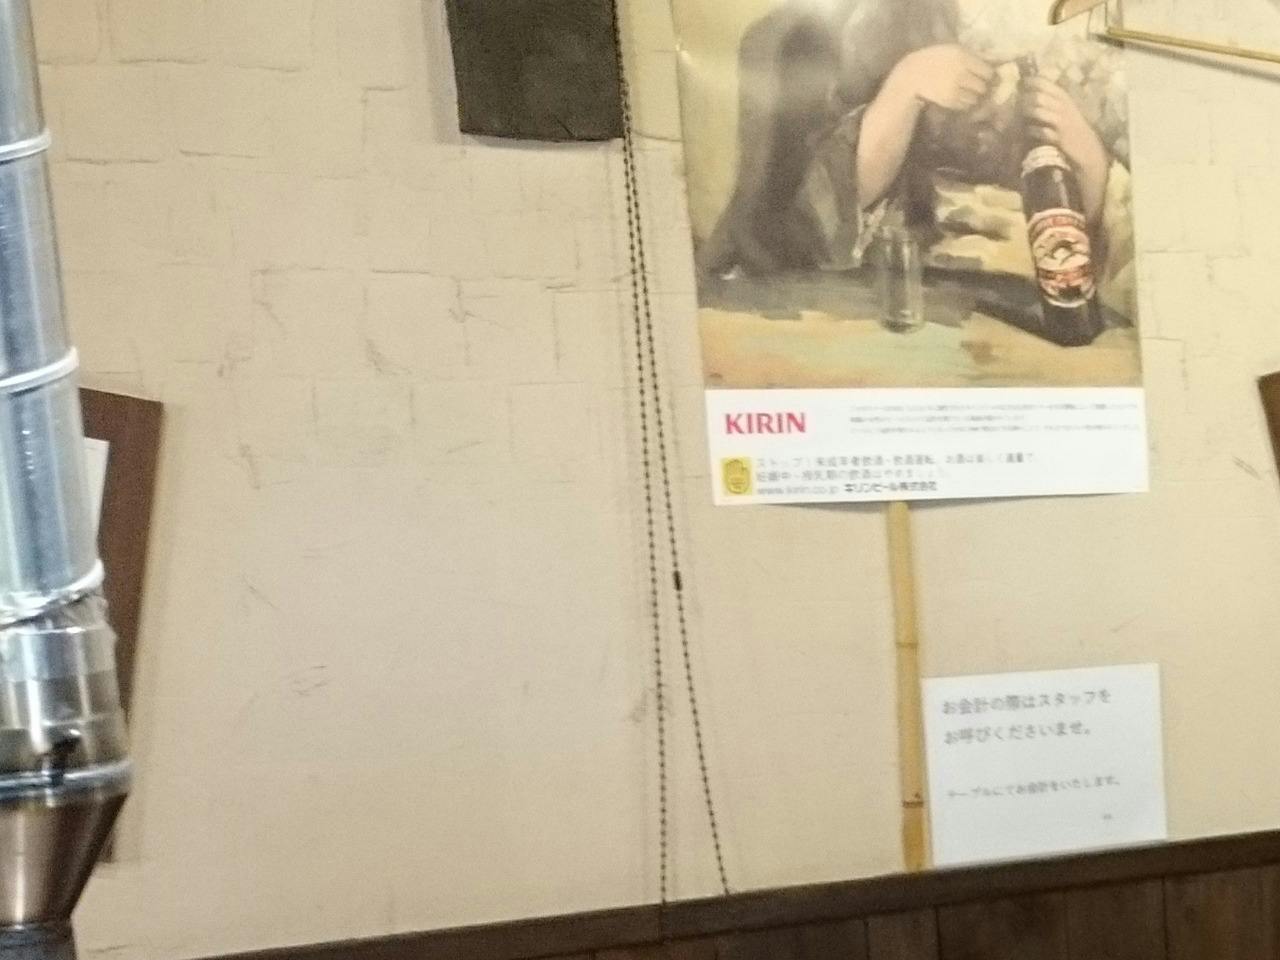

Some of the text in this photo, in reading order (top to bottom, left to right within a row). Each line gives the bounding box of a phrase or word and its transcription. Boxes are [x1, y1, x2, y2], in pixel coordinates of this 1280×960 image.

[725, 412, 807, 434] KIRIN
[844, 481, 938, 493] キリンビール株式会社
[943, 688, 1112, 716] お会計の際はスタッフを
[944, 720, 1092, 745] お呼びくださいませ。
